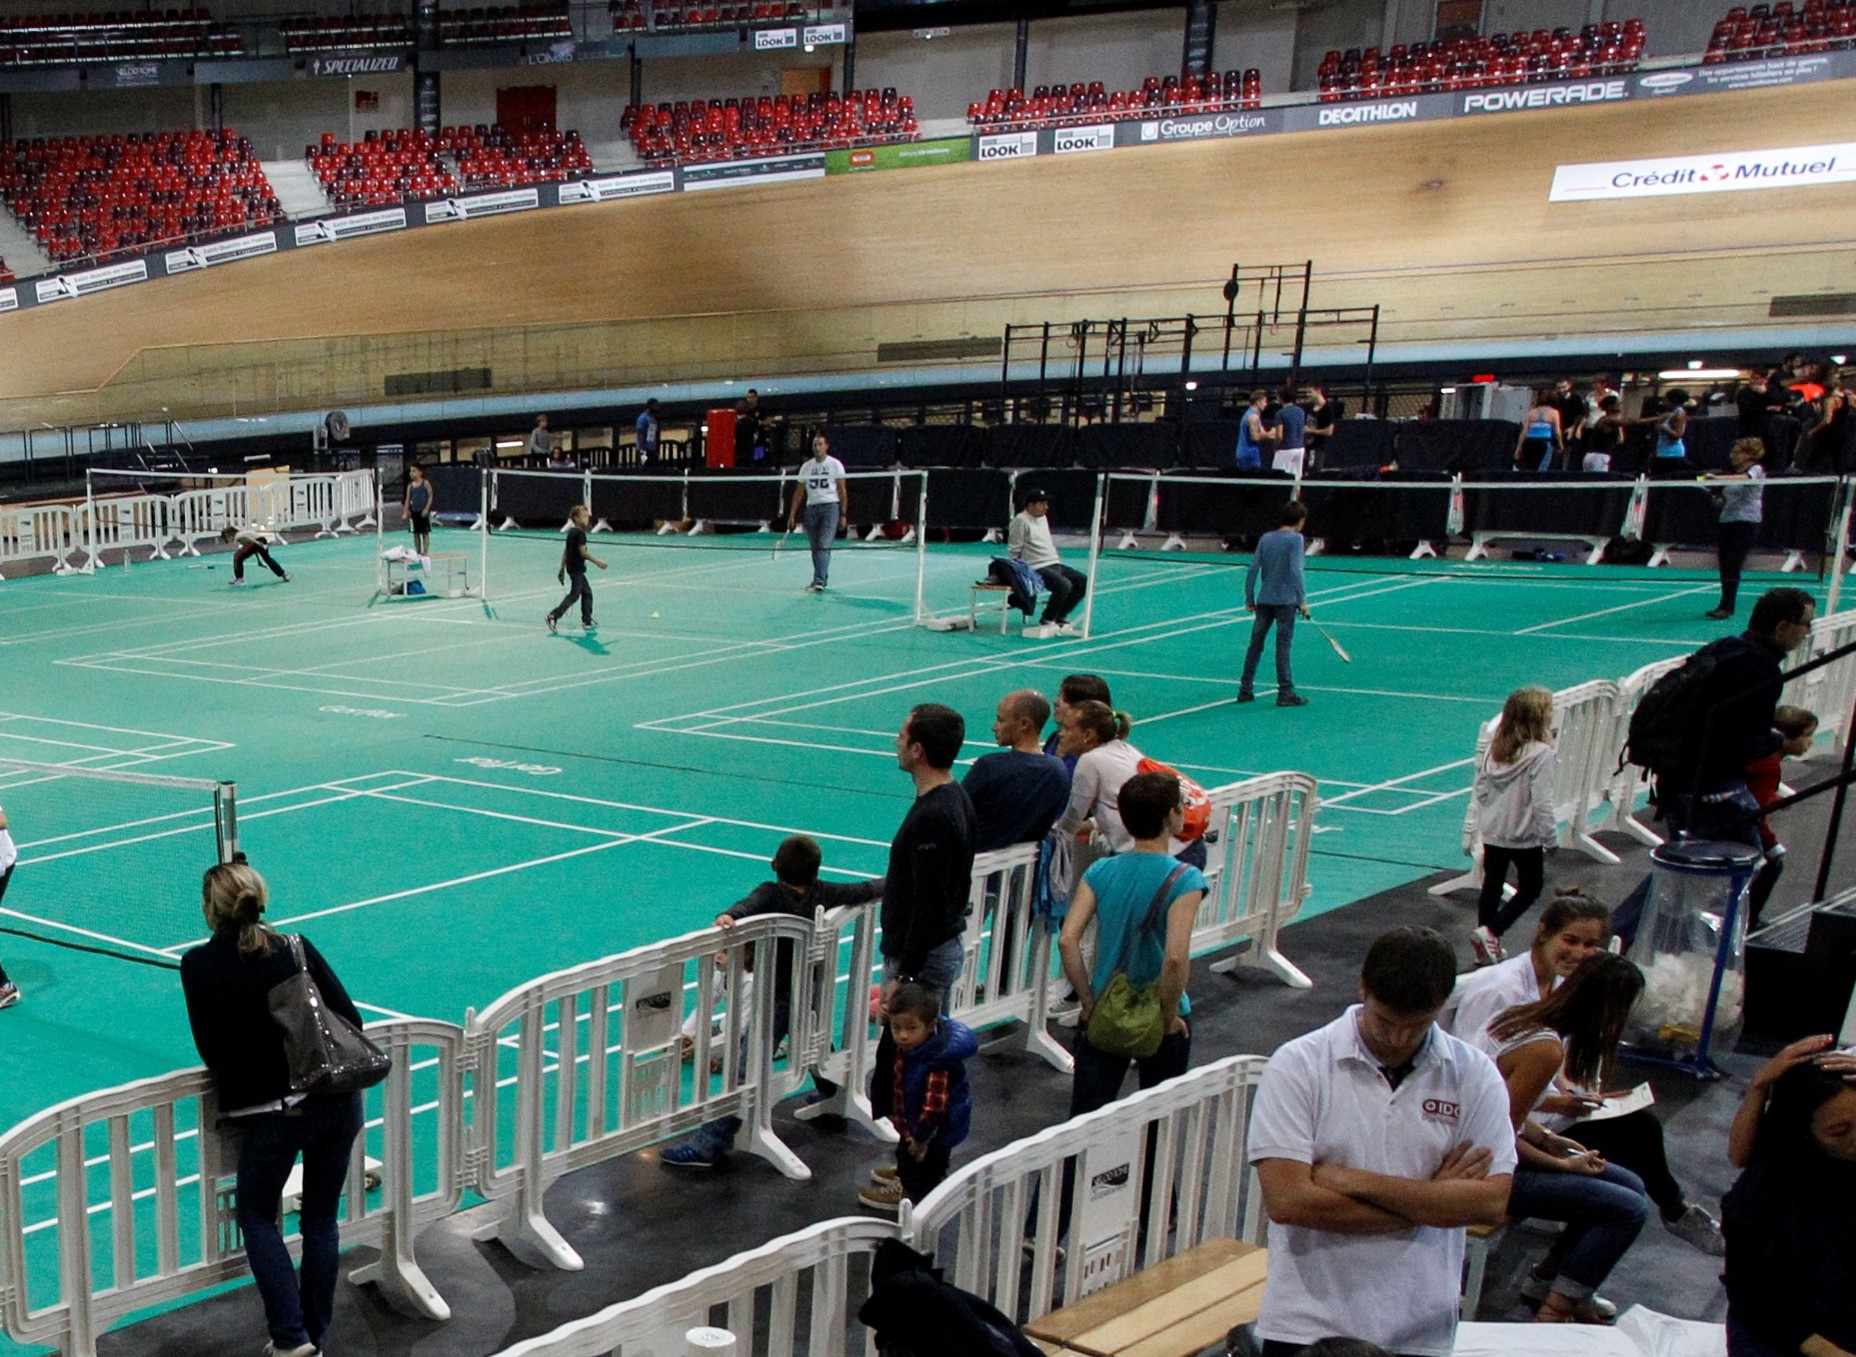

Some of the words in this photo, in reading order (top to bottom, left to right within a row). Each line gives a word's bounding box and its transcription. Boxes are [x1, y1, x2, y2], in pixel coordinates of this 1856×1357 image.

[757, 37, 783, 47] LOOK
[806, 34, 832, 43] LOOK
[323, 56, 399, 74] SPECIALIZED
[1463, 81, 1626, 113] POWERADE
[1318, 102, 1417, 125] DECATHLON
[1160, 120, 1214, 136] Groupe
[1215, 114, 1266, 136] Option
[981, 144, 1019, 158] LOOK
[1057, 137, 1095, 151] LOOK
[1611, 167, 1697, 188] Crédit
[1734, 157, 1837, 179] Mutuel
